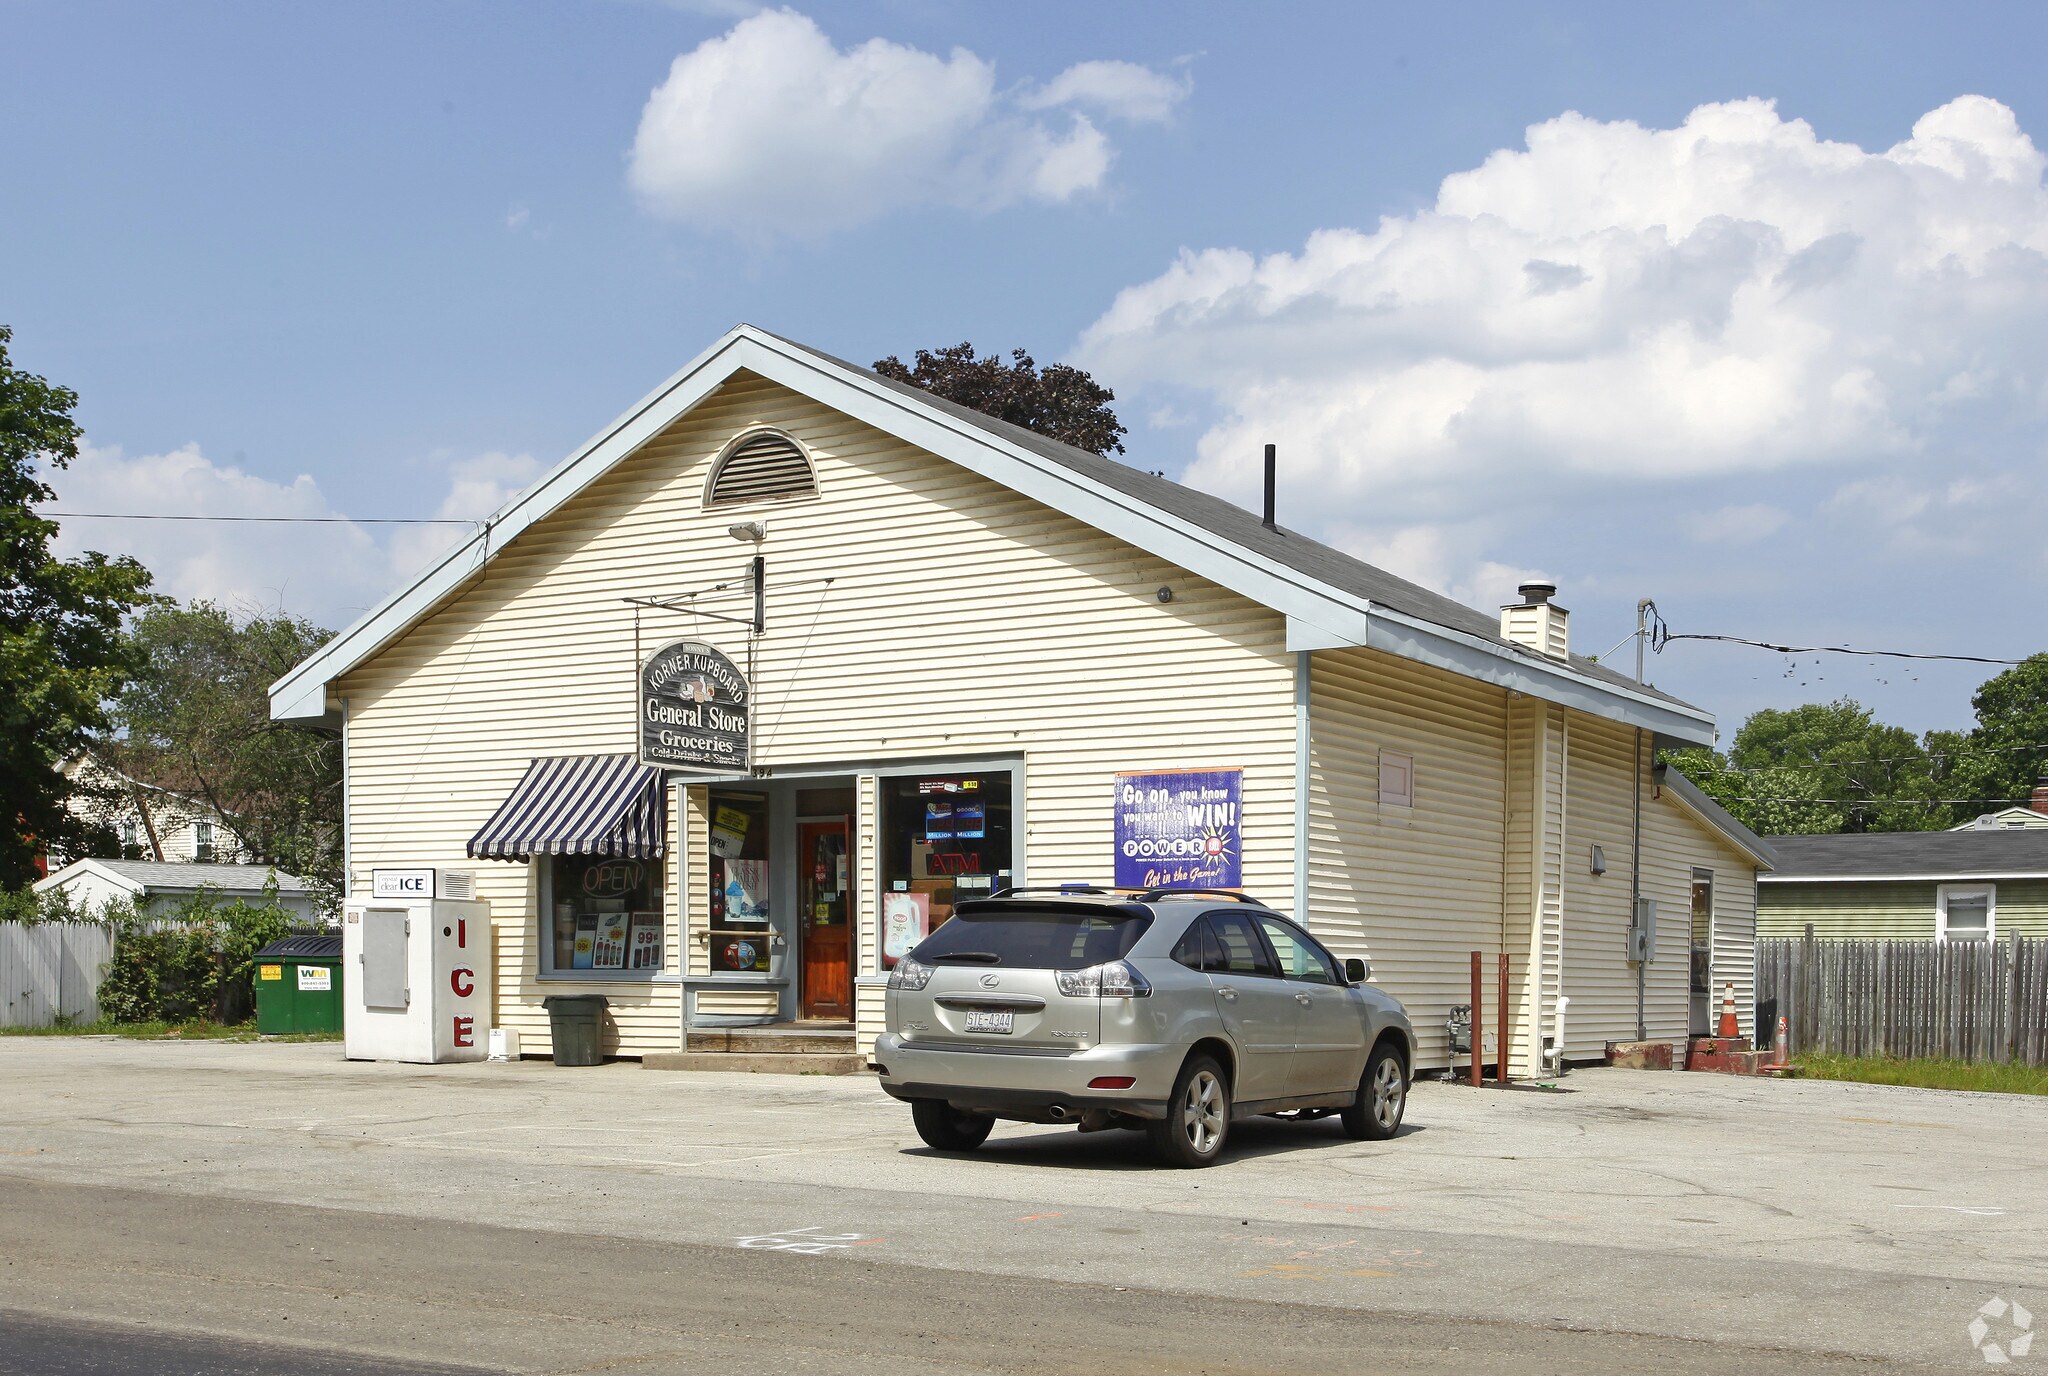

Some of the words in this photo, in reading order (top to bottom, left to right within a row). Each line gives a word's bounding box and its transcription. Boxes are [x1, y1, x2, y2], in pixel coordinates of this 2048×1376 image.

[649, 654, 691, 691] KORNER
[694, 654, 743, 703] KUPBOARD
[647, 698, 703, 728] General
[709, 706, 745, 733] Store
[660, 729, 733, 753] Groceries
[652, 747, 671, 758] Cold
[1123, 784, 1144, 805] Go
[1180, 790, 1198, 803] you
[1201, 786, 1229, 800] know
[1123, 812, 1141, 826] you
[1144, 812, 1169, 822] want
[1173, 811, 1183, 821] to
[1187, 802, 1236, 827] WIN!
[710, 836, 726, 850] OPEN
[929, 853, 980, 875] ATM
[380, 882, 398, 891] clear
[400, 878, 424, 891] ICE
[584, 866, 639, 890] OPEN
[1144, 869, 1160, 887] Get
[1163, 868, 1171, 884] in
[1173, 866, 1188, 882] the
[1190, 867, 1221, 882] Game!
[300, 969, 328, 978] WM
[450, 913, 475, 1048] ICE
